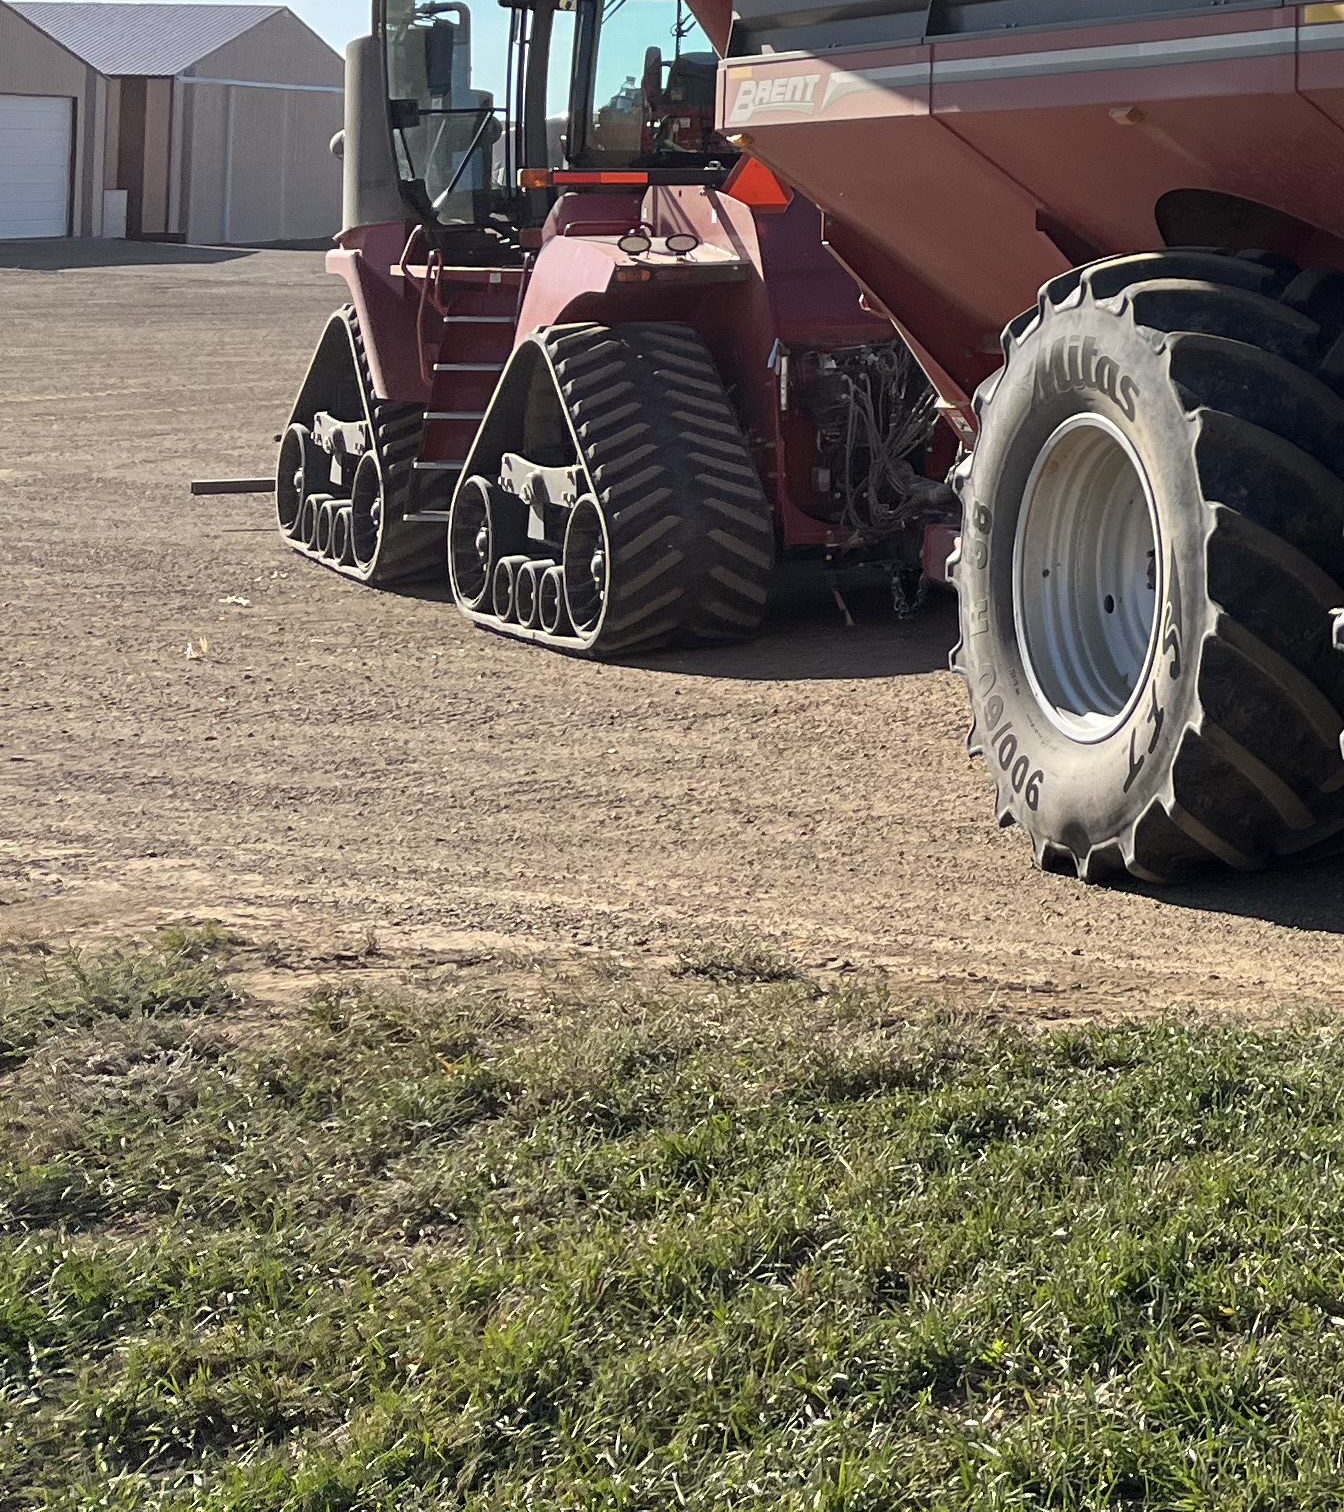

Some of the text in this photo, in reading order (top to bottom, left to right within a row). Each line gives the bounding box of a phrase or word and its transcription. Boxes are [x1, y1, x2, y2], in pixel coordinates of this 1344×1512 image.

[728, 73, 821, 123] BRENT
[1033, 334, 1141, 423] Mitas
[977, 662, 1045, 813] 900/60
